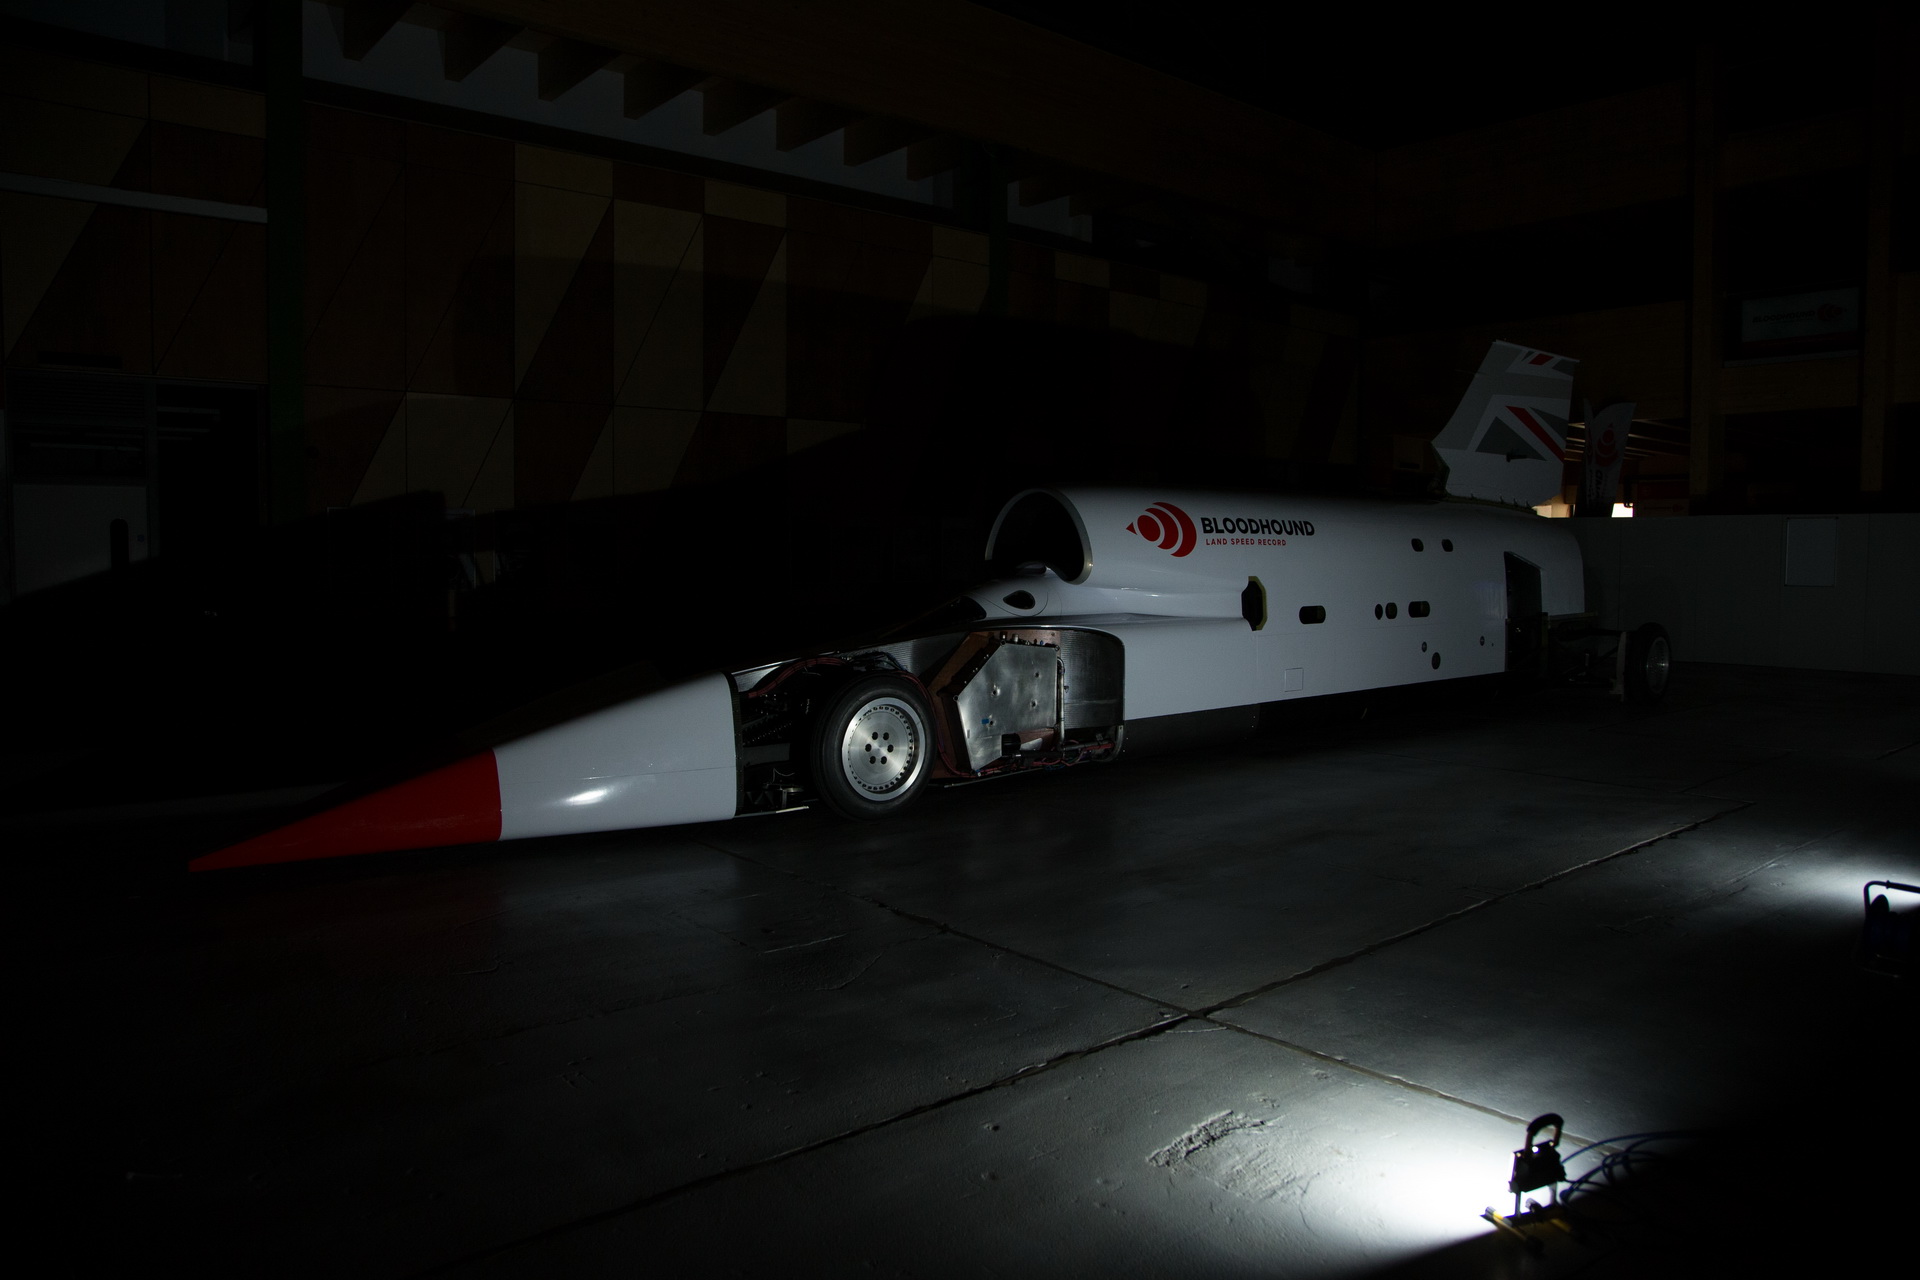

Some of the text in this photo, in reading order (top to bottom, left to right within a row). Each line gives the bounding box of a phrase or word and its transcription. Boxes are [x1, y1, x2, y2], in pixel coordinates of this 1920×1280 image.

[1200, 517, 1315, 536] BLOODHOUND
[1205, 538, 1287, 546] LAND SPEED RECORD
